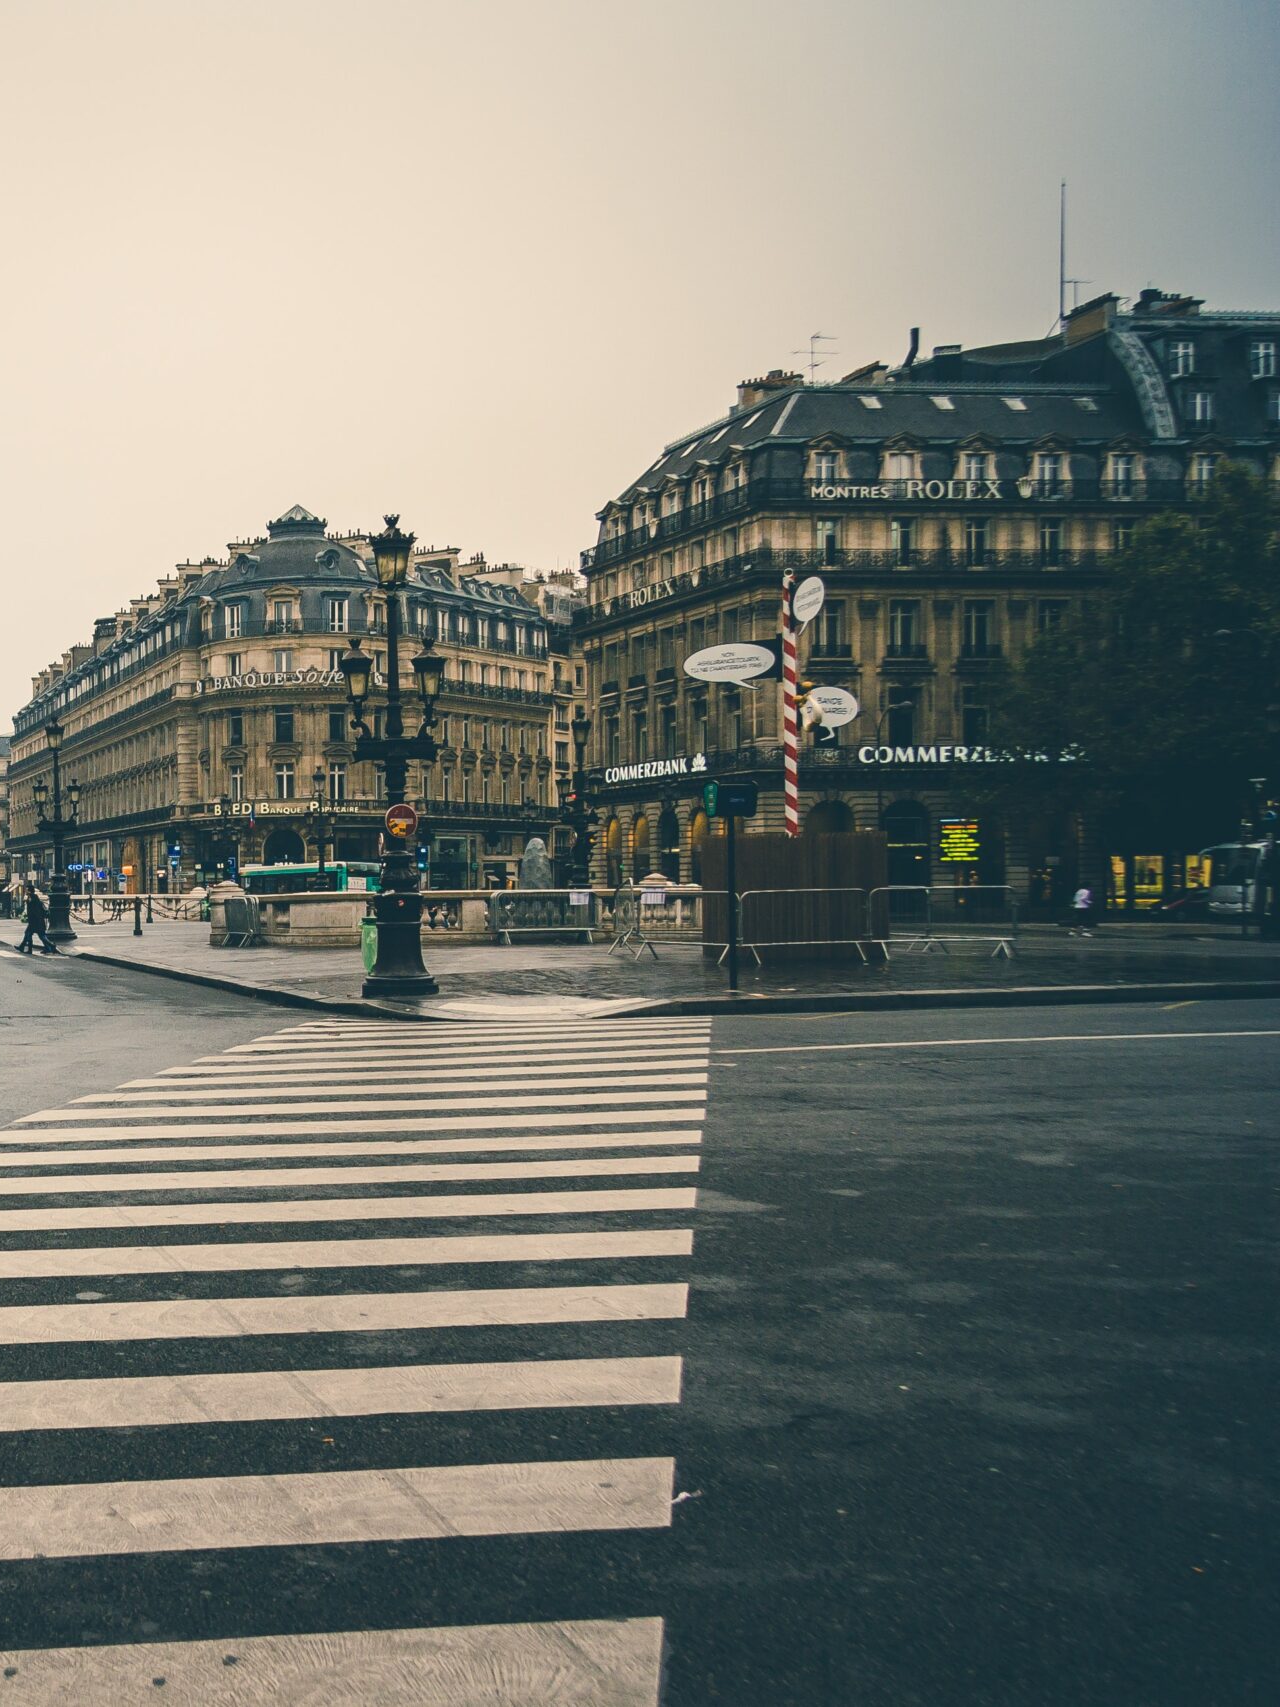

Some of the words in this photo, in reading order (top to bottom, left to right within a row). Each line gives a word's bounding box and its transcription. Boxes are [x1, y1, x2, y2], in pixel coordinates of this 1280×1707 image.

[811, 486, 889, 499] MONTRES
[906, 479, 1003, 499] ROLEX
[630, 579, 675, 608] ROLEX
[214, 672, 284, 690] BANQUE
[858, 746, 1050, 763] COMMERZ
[605, 758, 687, 784] COMMERZBANK
[214, 802, 252, 816] BED
